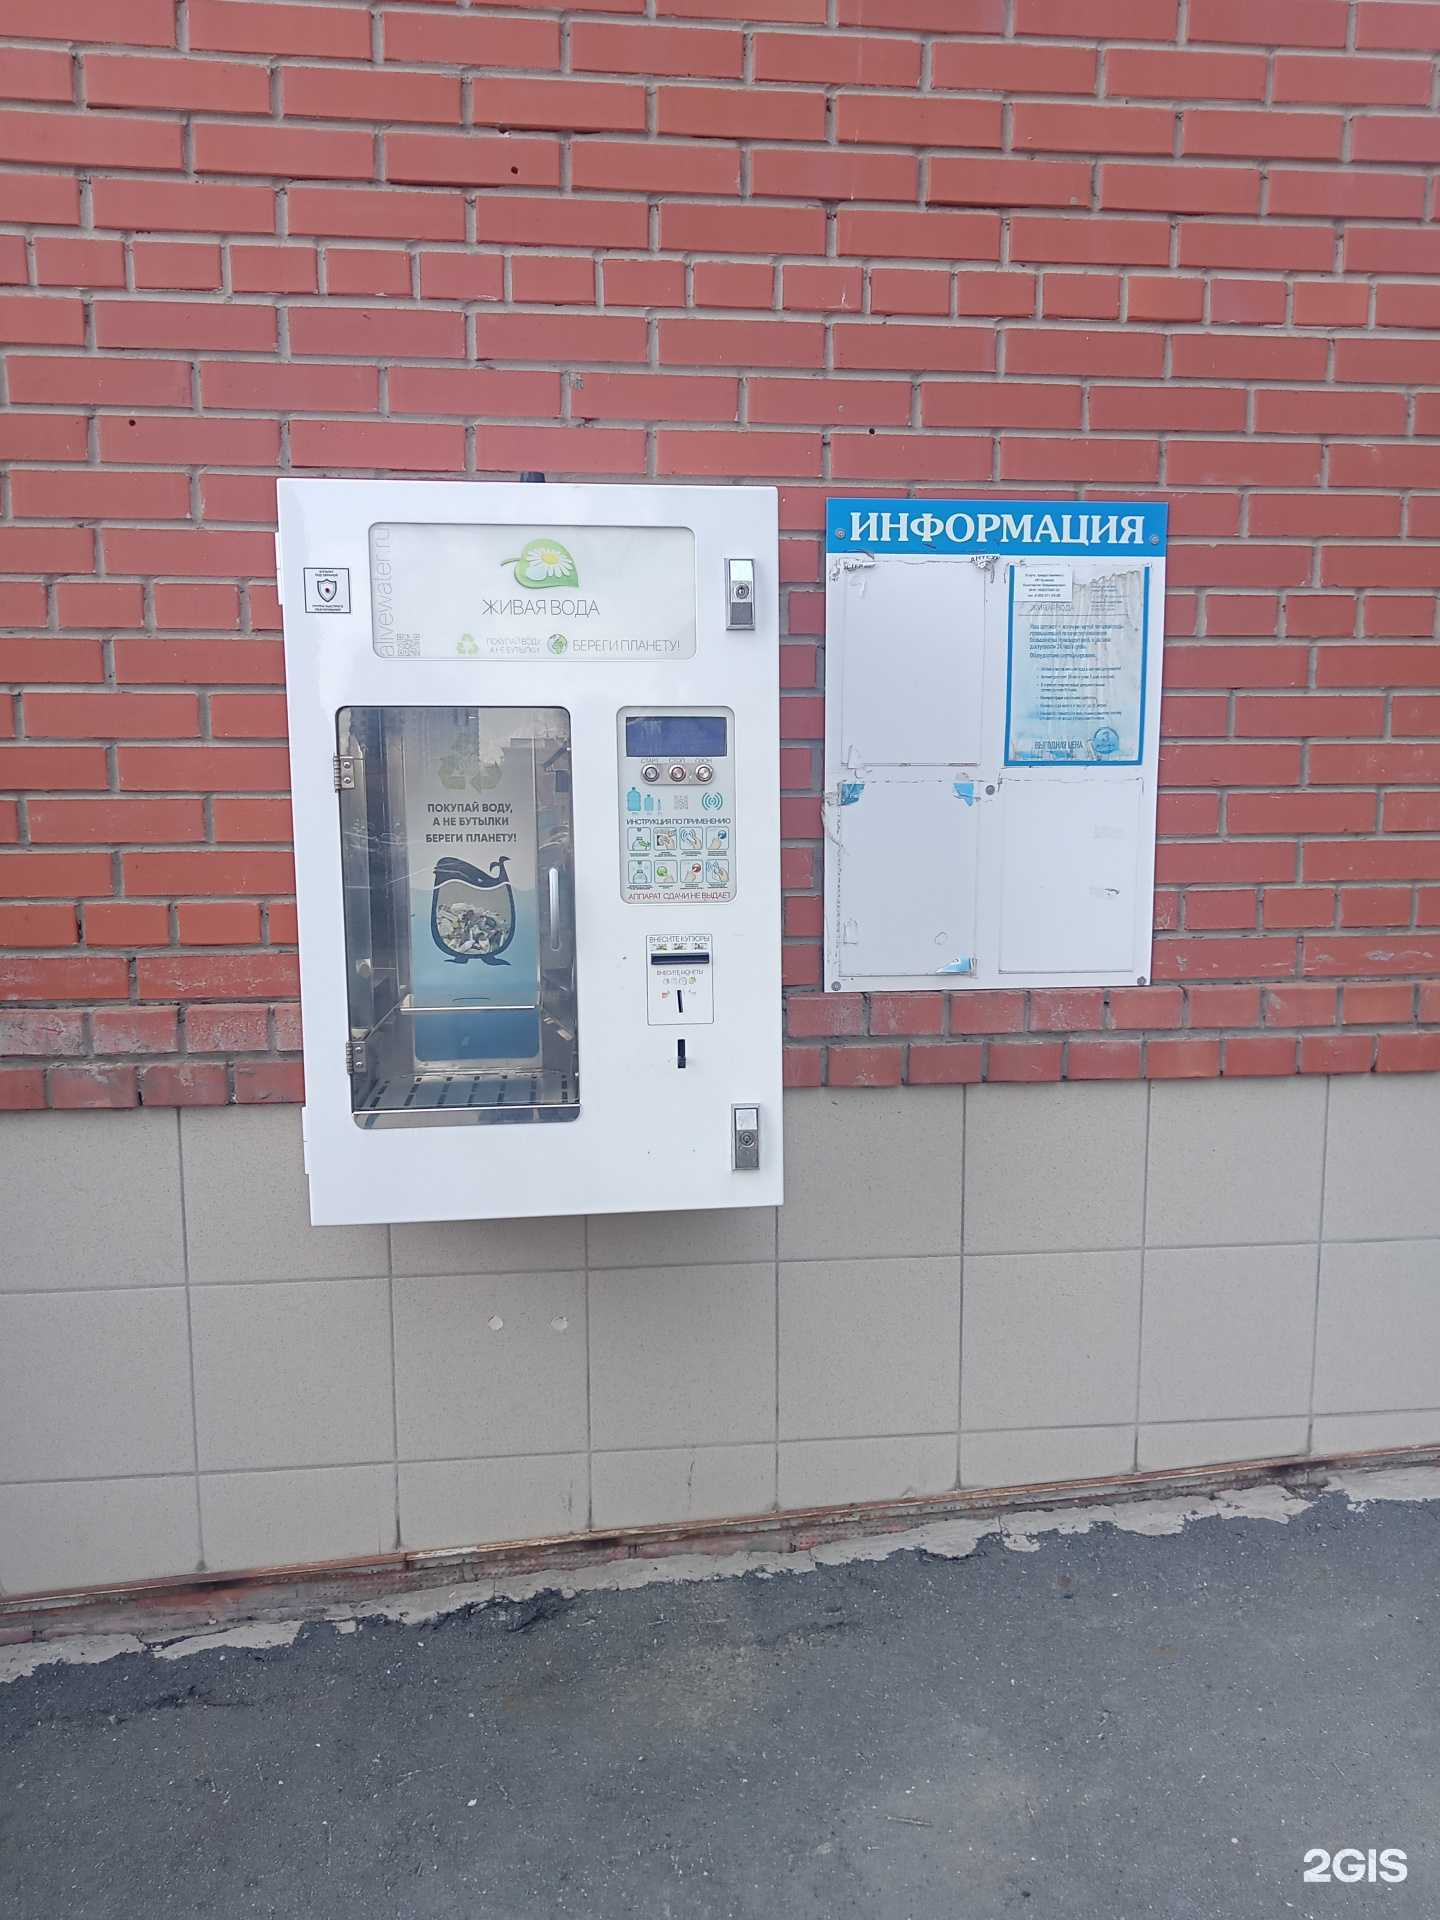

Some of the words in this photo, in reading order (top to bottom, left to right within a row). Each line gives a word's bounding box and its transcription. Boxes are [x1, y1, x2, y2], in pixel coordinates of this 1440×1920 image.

[850, 512, 1145, 546] ИНФОРМАЦИЯ
[376, 527, 394, 656] alivewater.ru
[481, 599, 547, 616] ЖИВАЯ
[550, 599, 600, 617] ВОДА
[572, 639, 618, 652] БЕРЕГИ
[620, 639, 680, 652] ПЛАНЕТУ!
[427, 801, 479, 813] ПОКУПАЙ
[482, 803, 513, 814] ВОДУ,
[433, 817, 440, 826] А
[443, 817, 456, 826] НЕ
[459, 817, 509, 826] БУТЫЛКИ
[425, 833, 464, 843] БЕРЕГИ
[466, 833, 517, 843] ПЛАНЕТУ!
[629, 892, 661, 900] АППАРАТ
[663, 892, 690, 900] СДАЧИ
